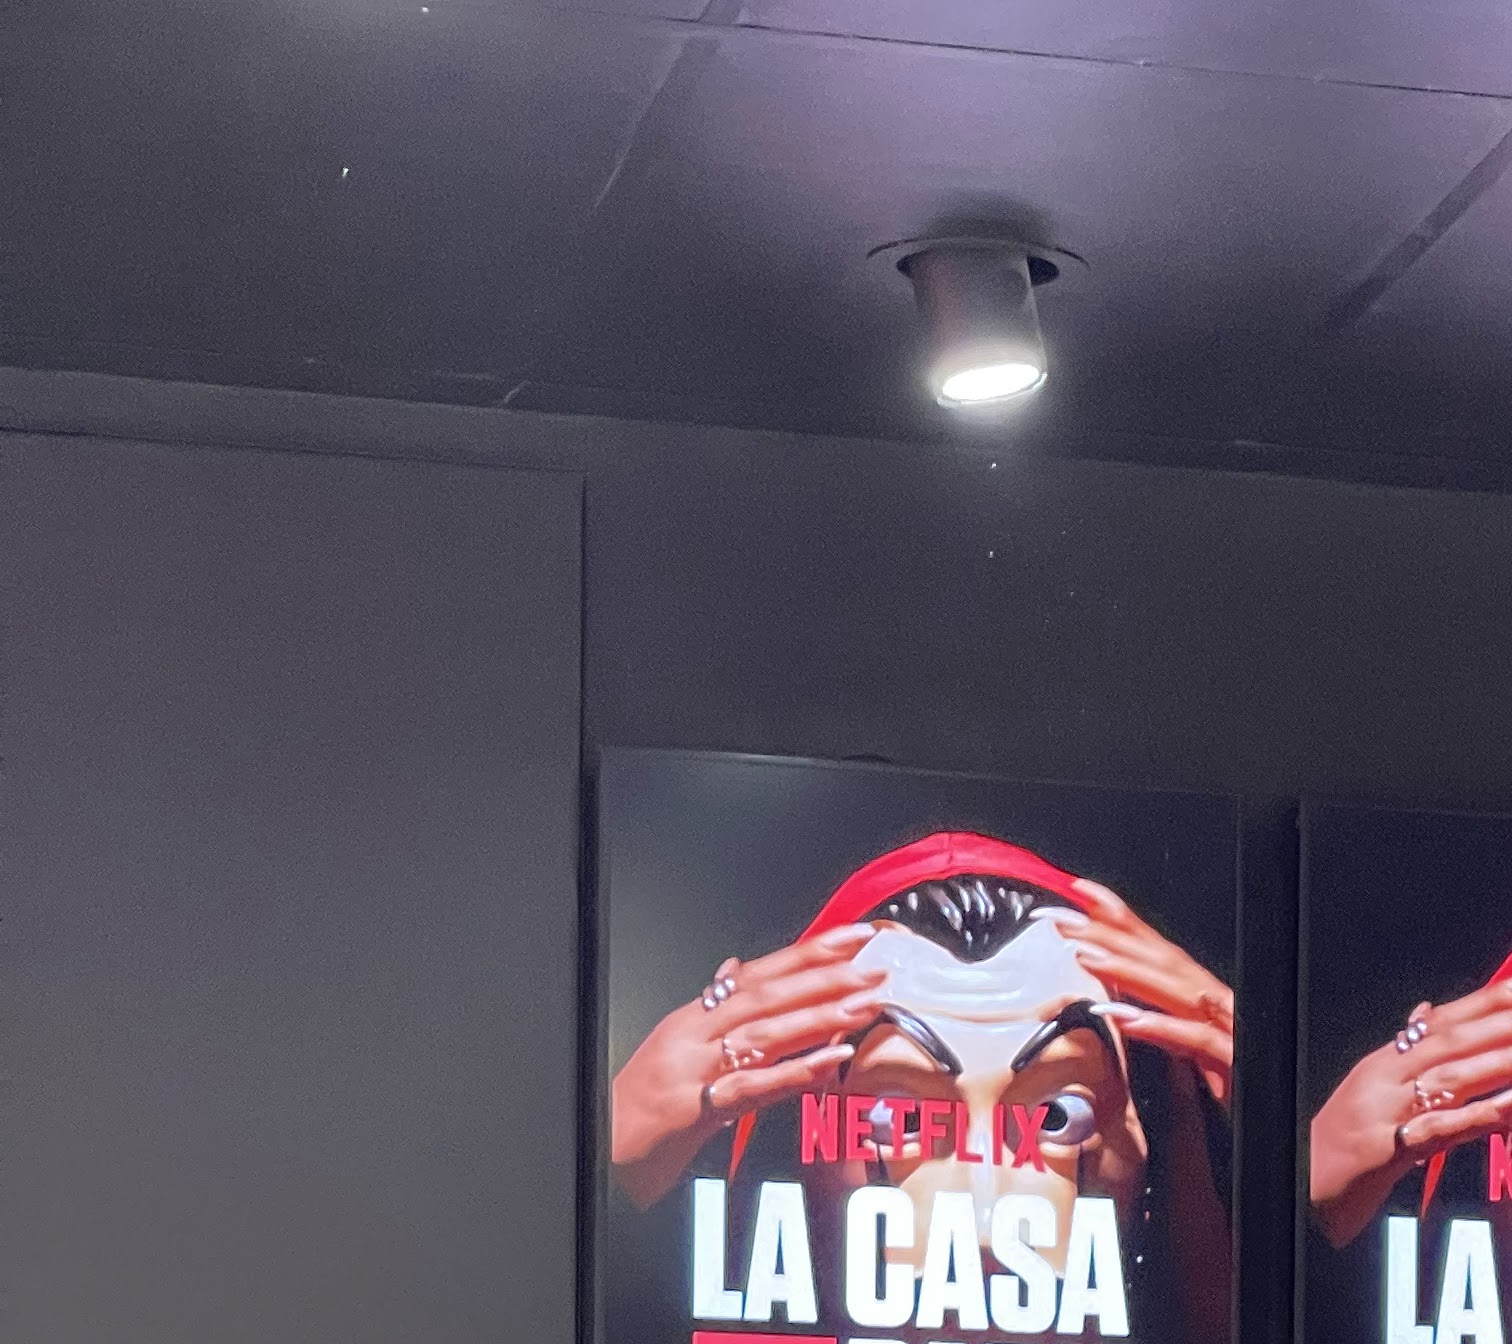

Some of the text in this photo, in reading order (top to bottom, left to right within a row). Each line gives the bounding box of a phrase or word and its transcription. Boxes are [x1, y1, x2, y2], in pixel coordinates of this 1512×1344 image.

[801, 1093, 1050, 1174] NETFLIX
[691, 1178, 1130, 1337] LA CASA
